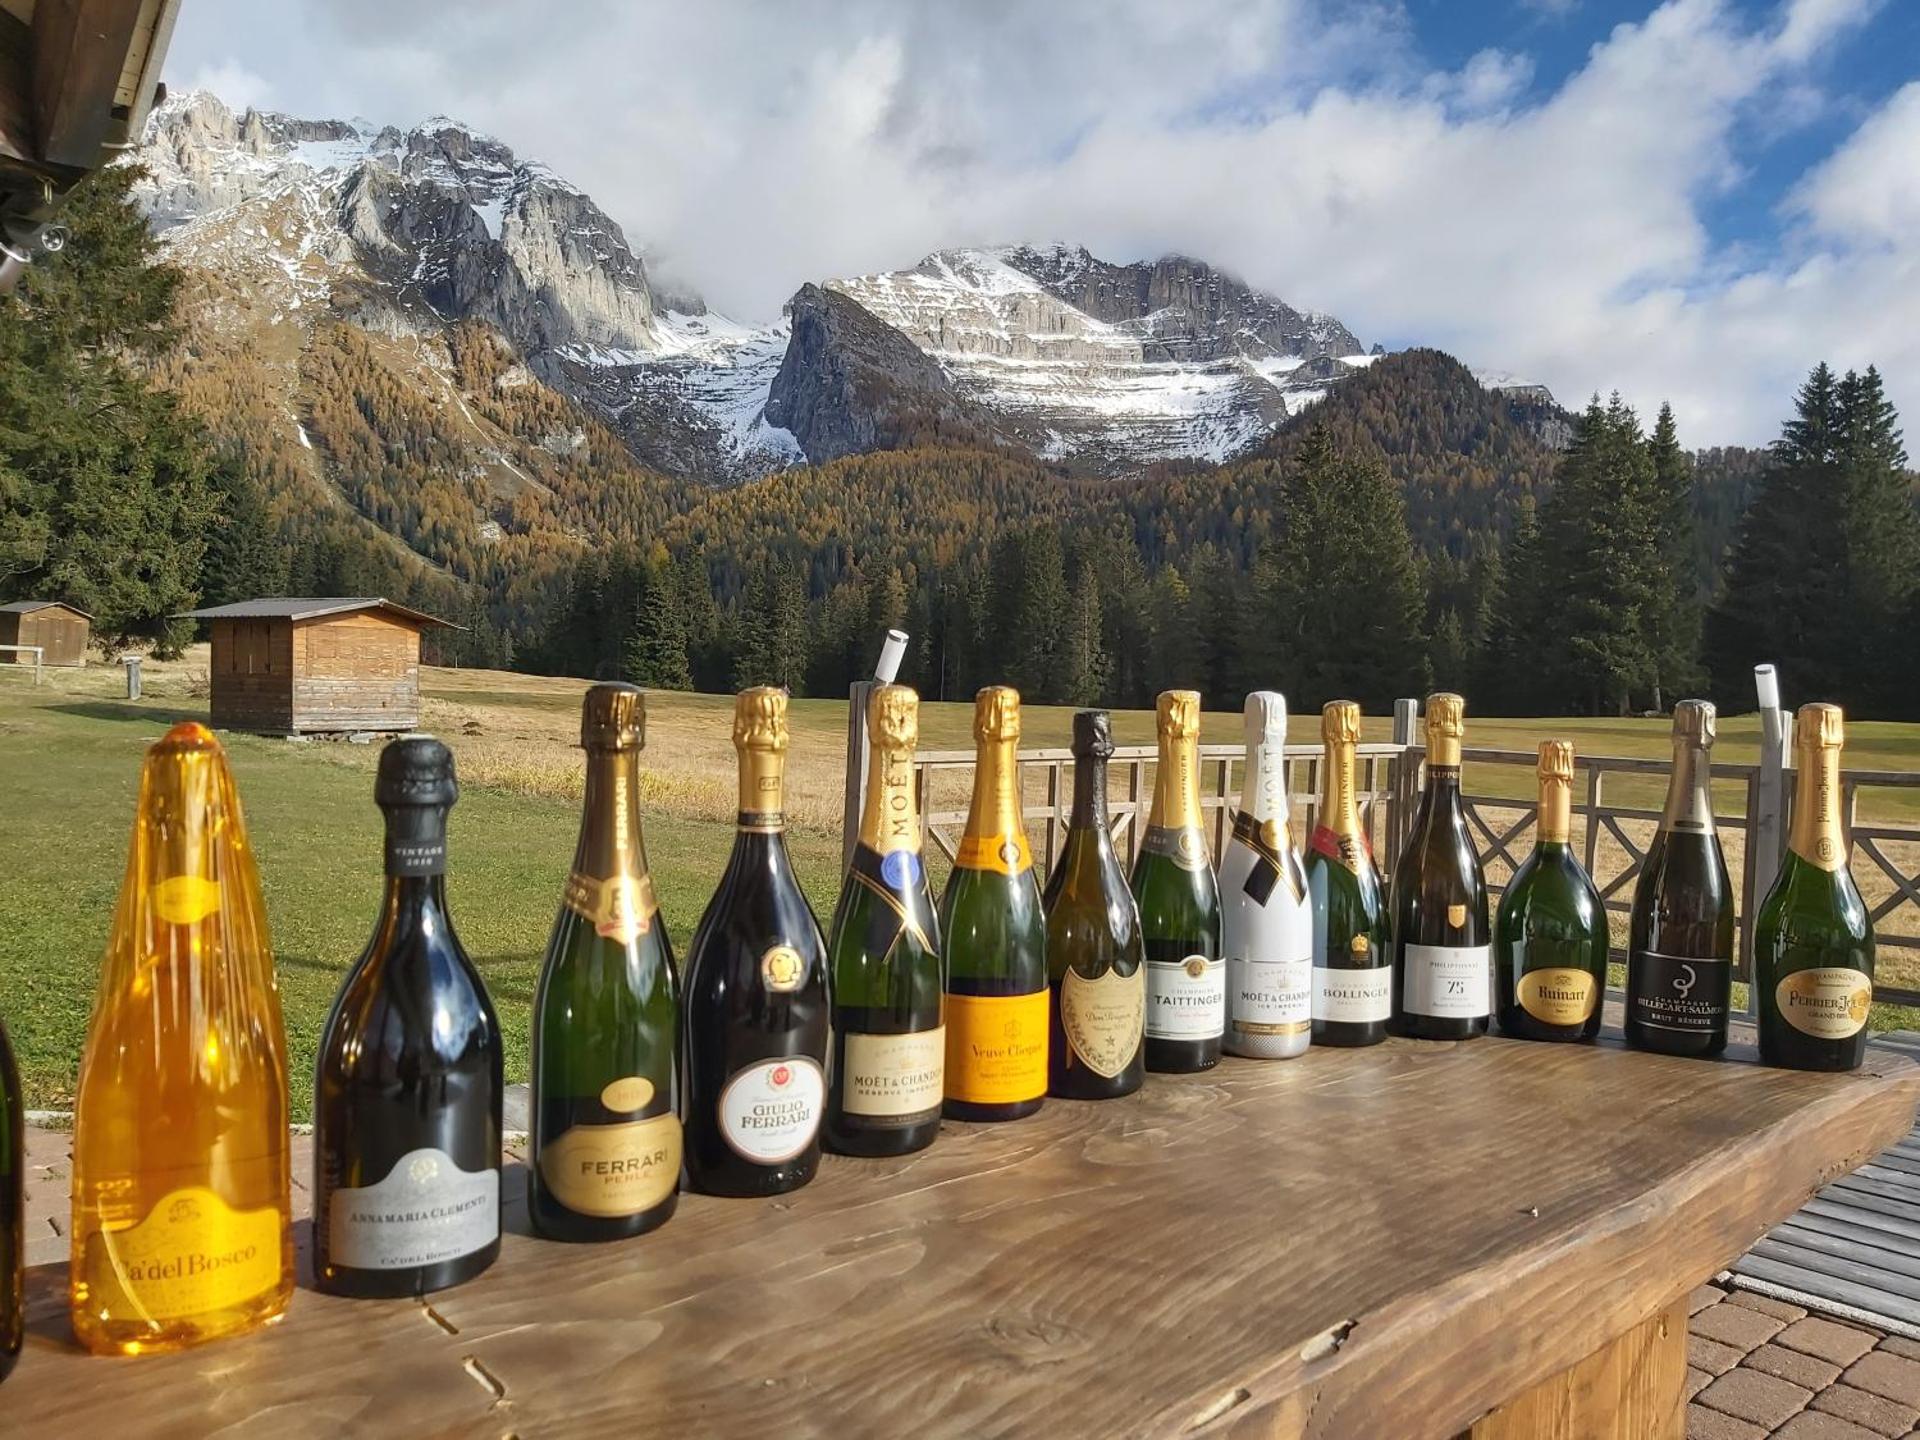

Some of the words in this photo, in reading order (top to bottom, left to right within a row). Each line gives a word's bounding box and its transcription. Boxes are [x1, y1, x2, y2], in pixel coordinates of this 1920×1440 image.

[615, 776, 628, 849] FERRARI
[1154, 993, 1222, 1006] TAITTINGER
[753, 1100, 803, 1117] GIULIO
[741, 1109, 810, 1129] FERRARI
[581, 1149, 668, 1175] FERRARI
[350, 1209, 429, 1224] ANNAMARIA
[188, 1245, 257, 1275] Bosco
